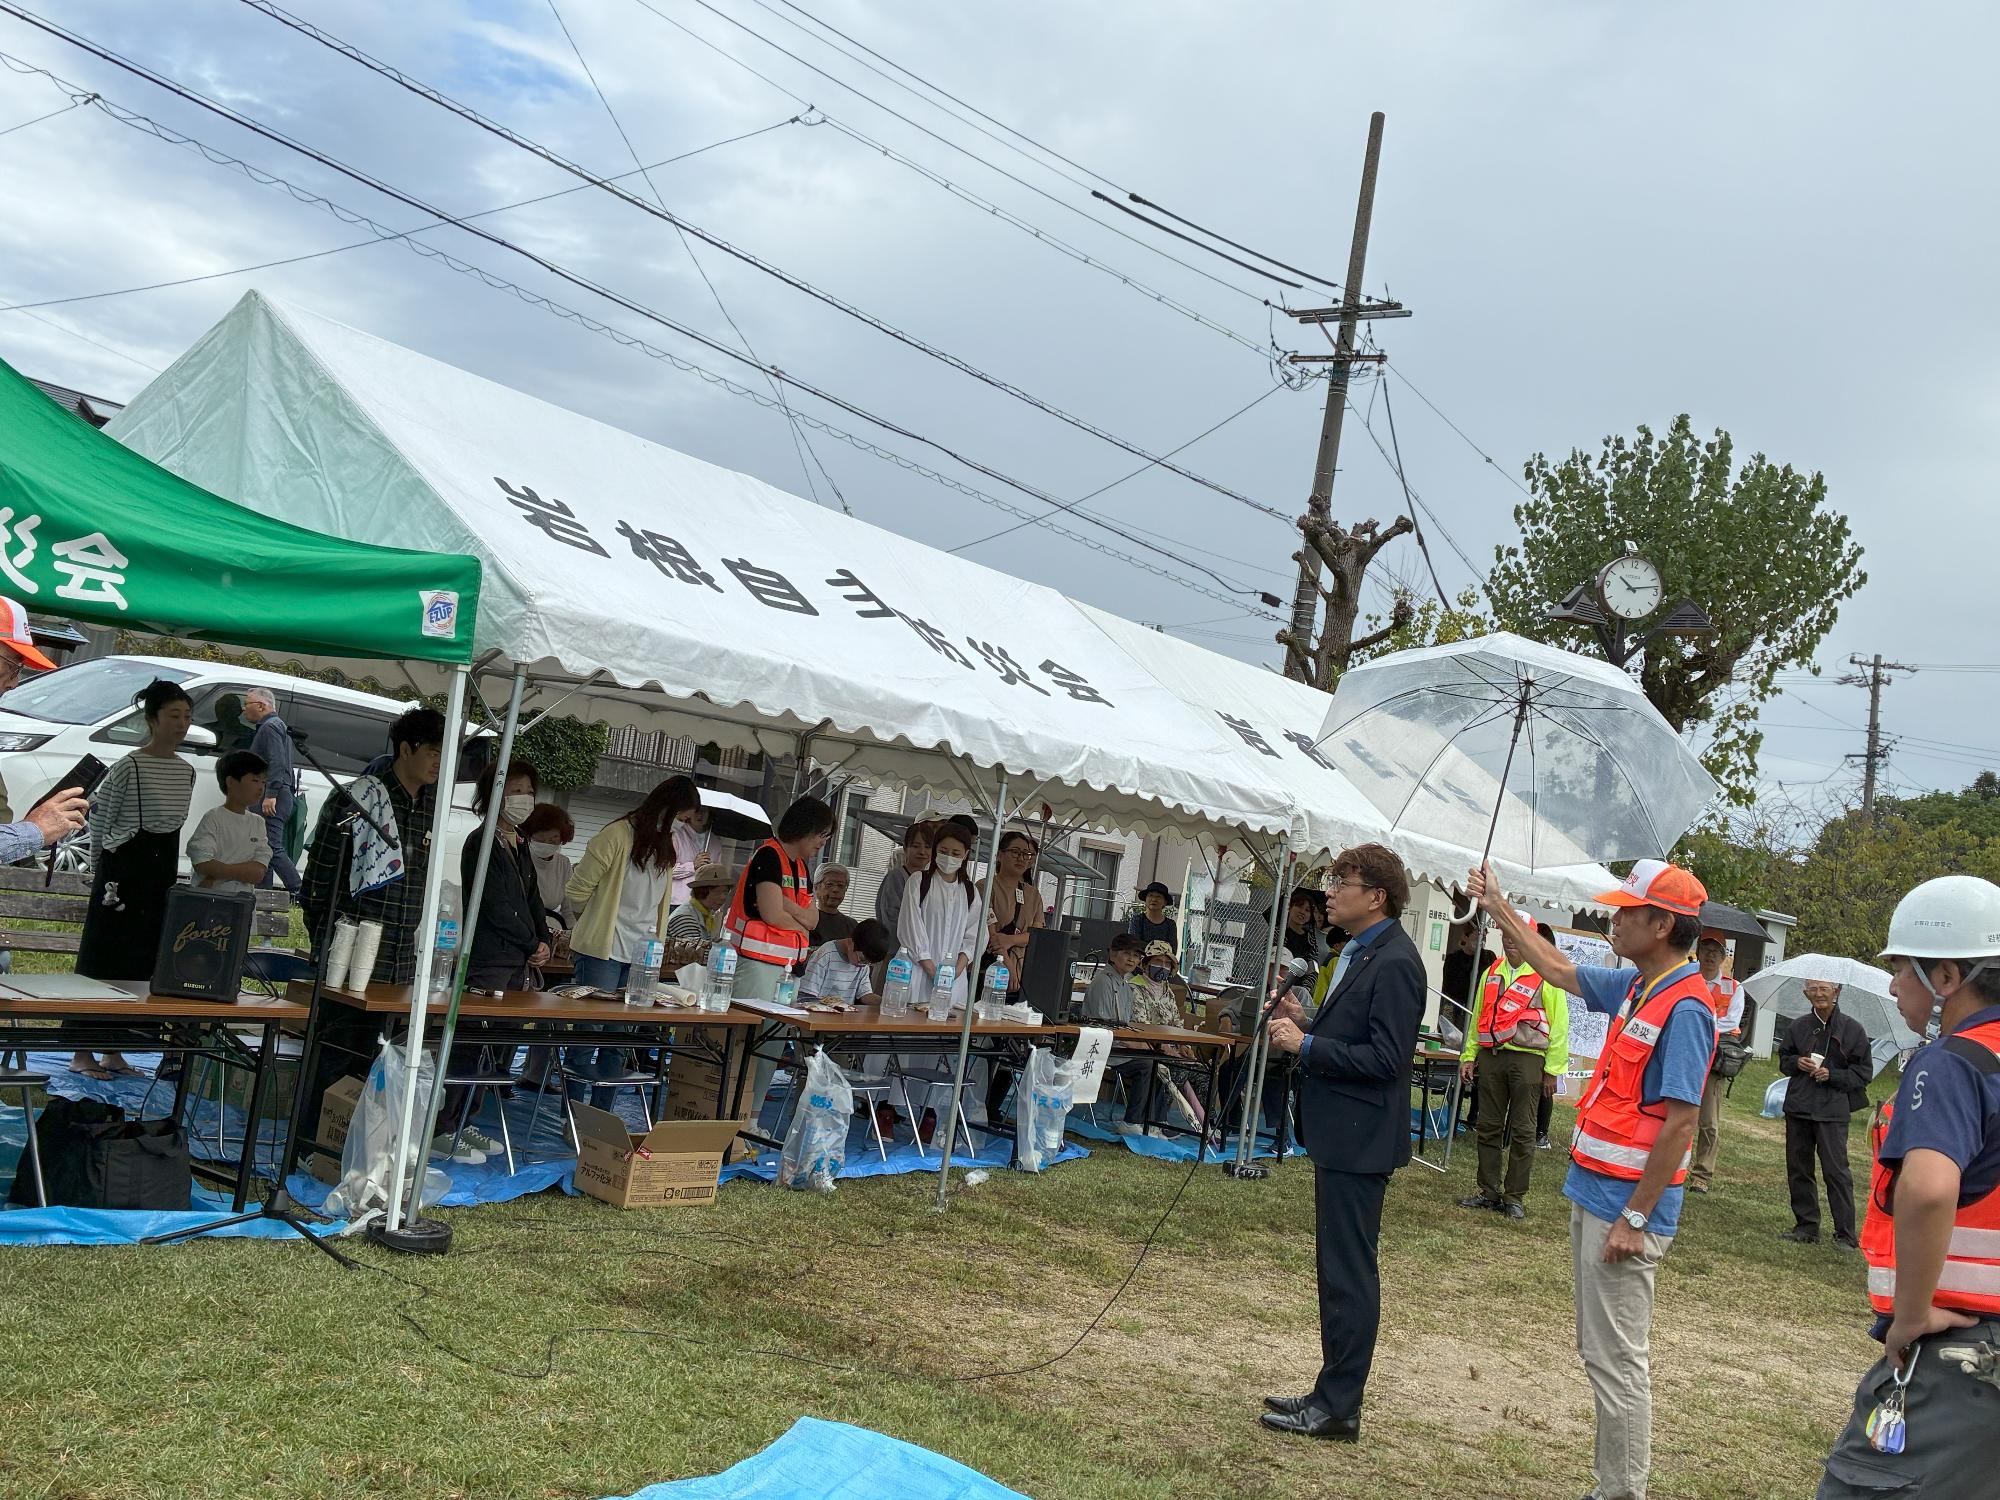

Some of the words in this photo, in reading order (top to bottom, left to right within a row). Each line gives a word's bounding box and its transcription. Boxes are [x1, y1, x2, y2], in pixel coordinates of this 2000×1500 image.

[1631, 561, 1638, 569] 12
[1653, 588, 1659, 596] 3
[1626, 608, 1631, 616] 6
[1629, 1021, 1651, 1040] 防災
[1081, 1038, 1100, 1080] 本部
